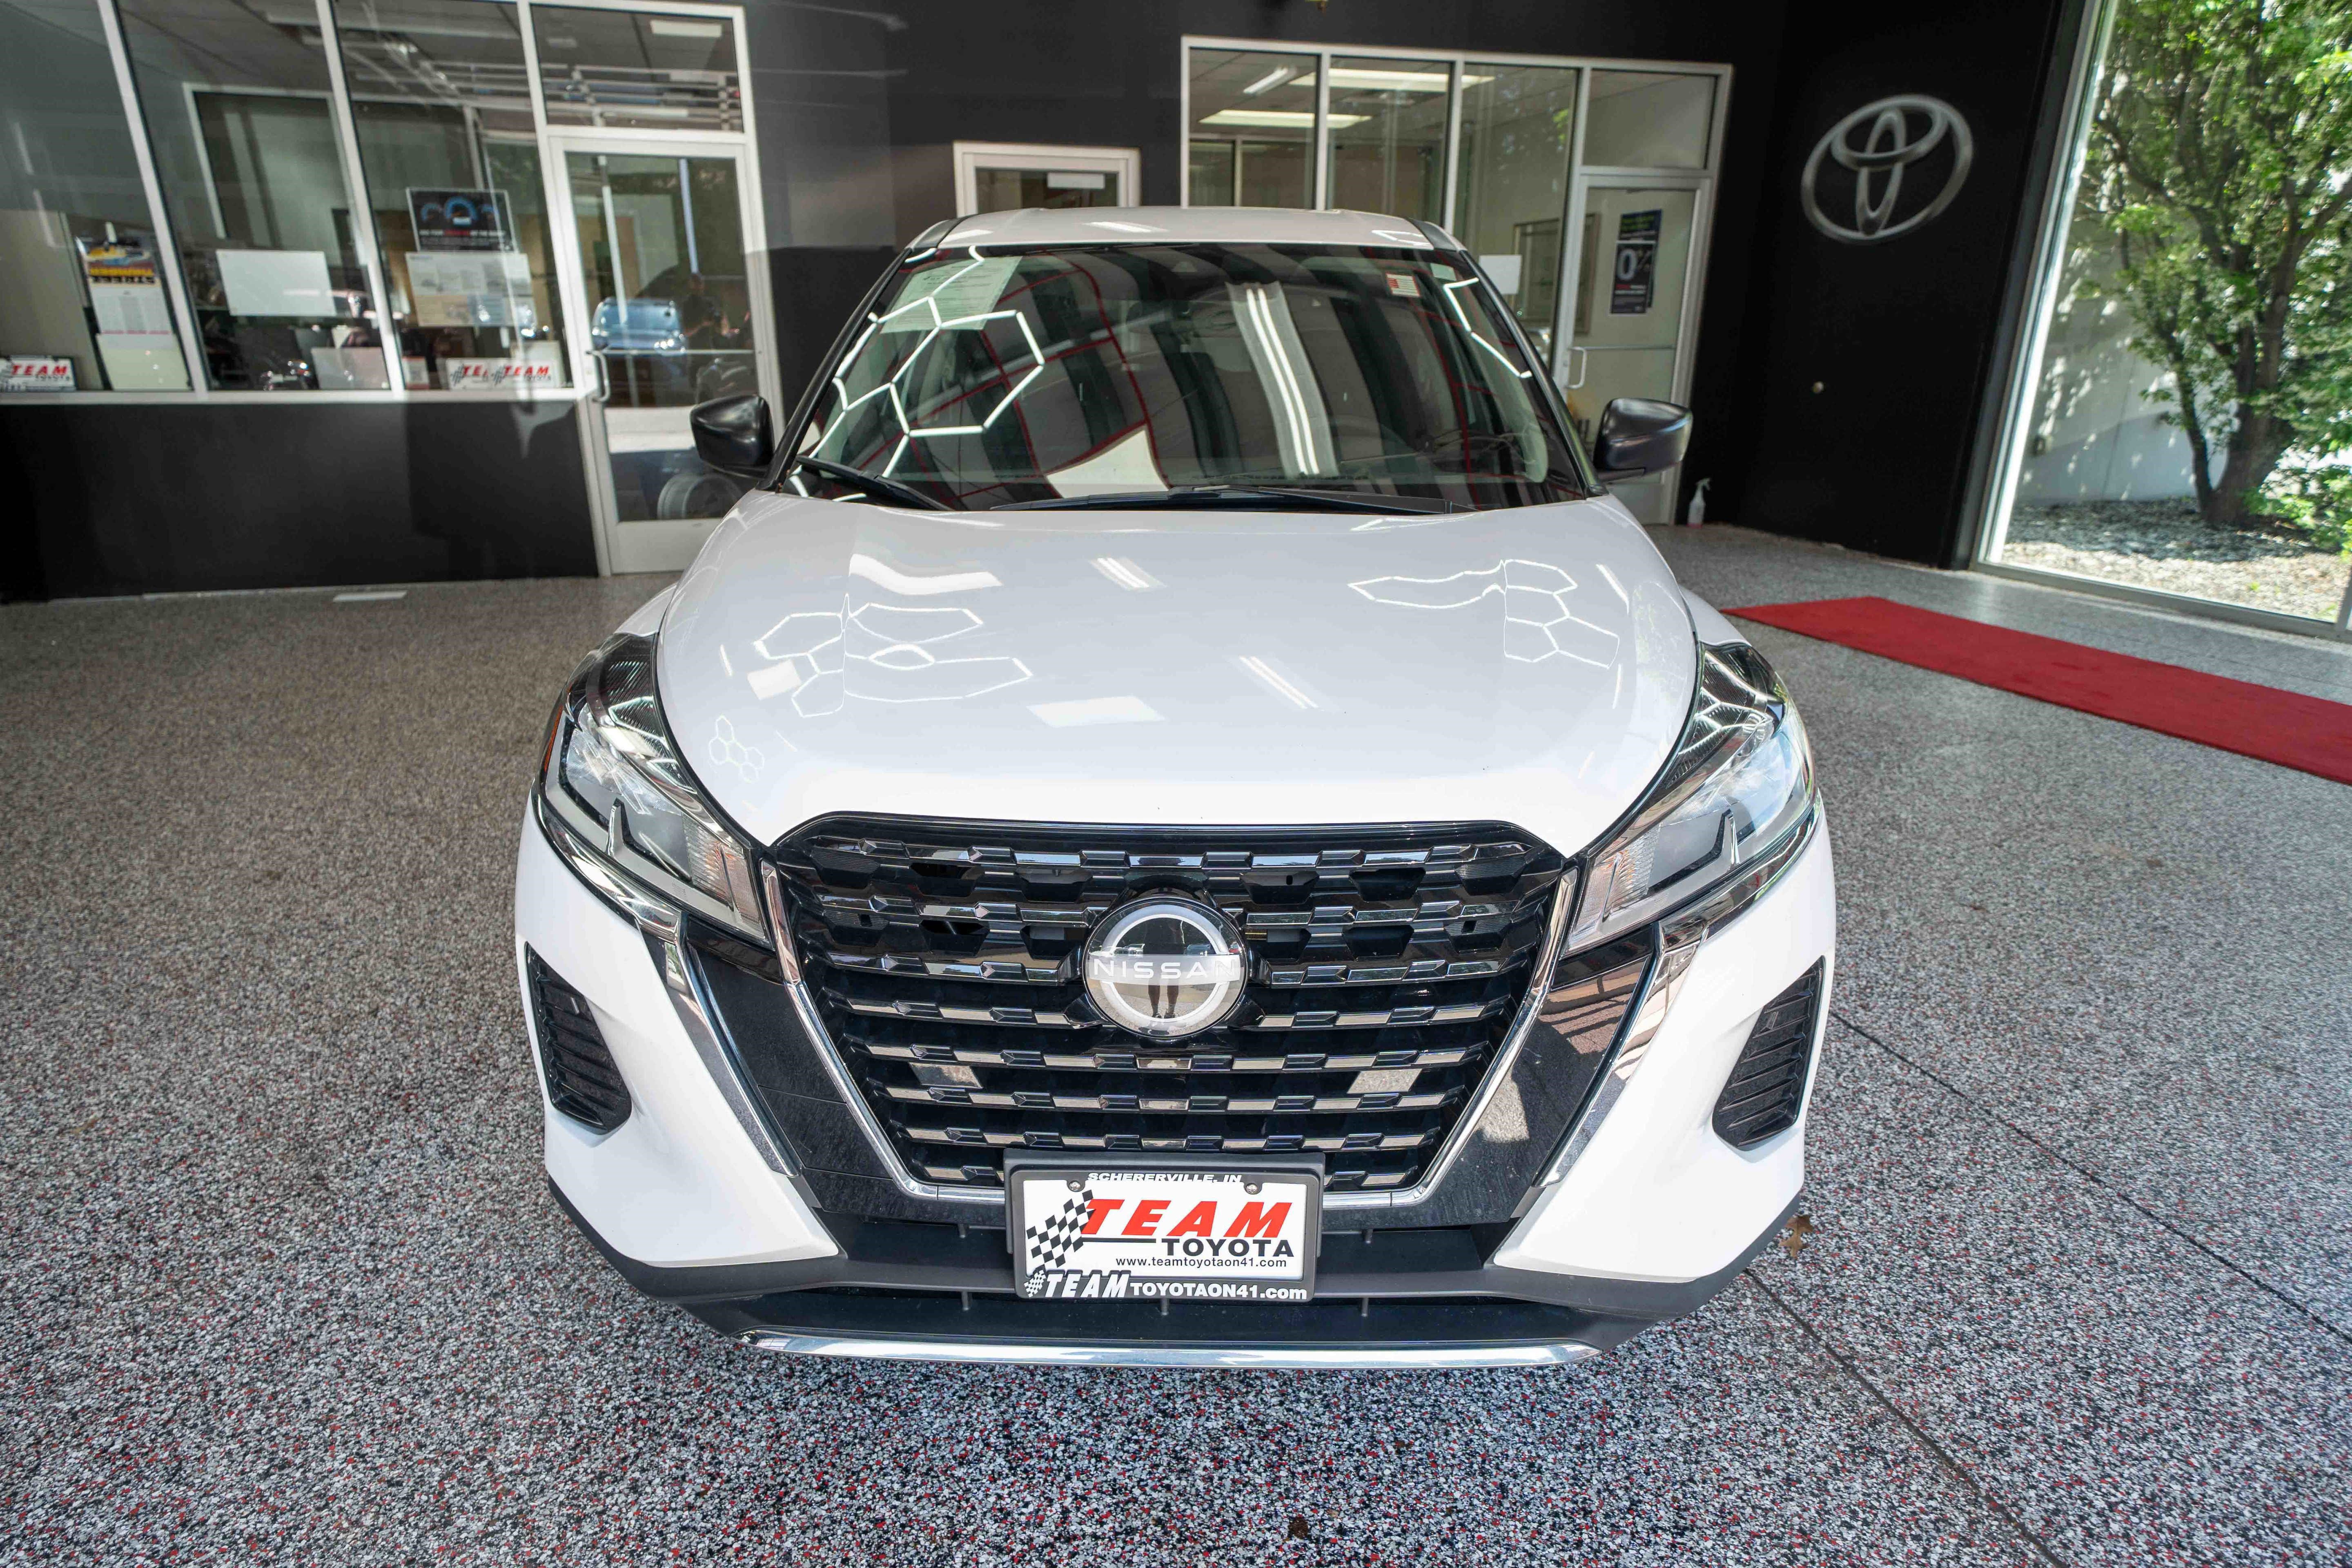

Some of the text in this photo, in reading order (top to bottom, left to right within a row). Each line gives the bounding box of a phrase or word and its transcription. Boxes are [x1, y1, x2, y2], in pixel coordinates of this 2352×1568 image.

[11, 365, 68, 375] TEAM
[504, 365, 549, 376] TEAM
[1094, 958, 1235, 979] NISSAN
[1223, 1174, 1242, 1183] IN
[1081, 1199, 1292, 1238] TEAM
[1162, 1238, 1294, 1257] TOYOTA
[1116, 1257, 1286, 1268] www.teamtoyotaon41.com
[1045, 1274, 1307, 1300] TEAM TOYOTAON41.com
